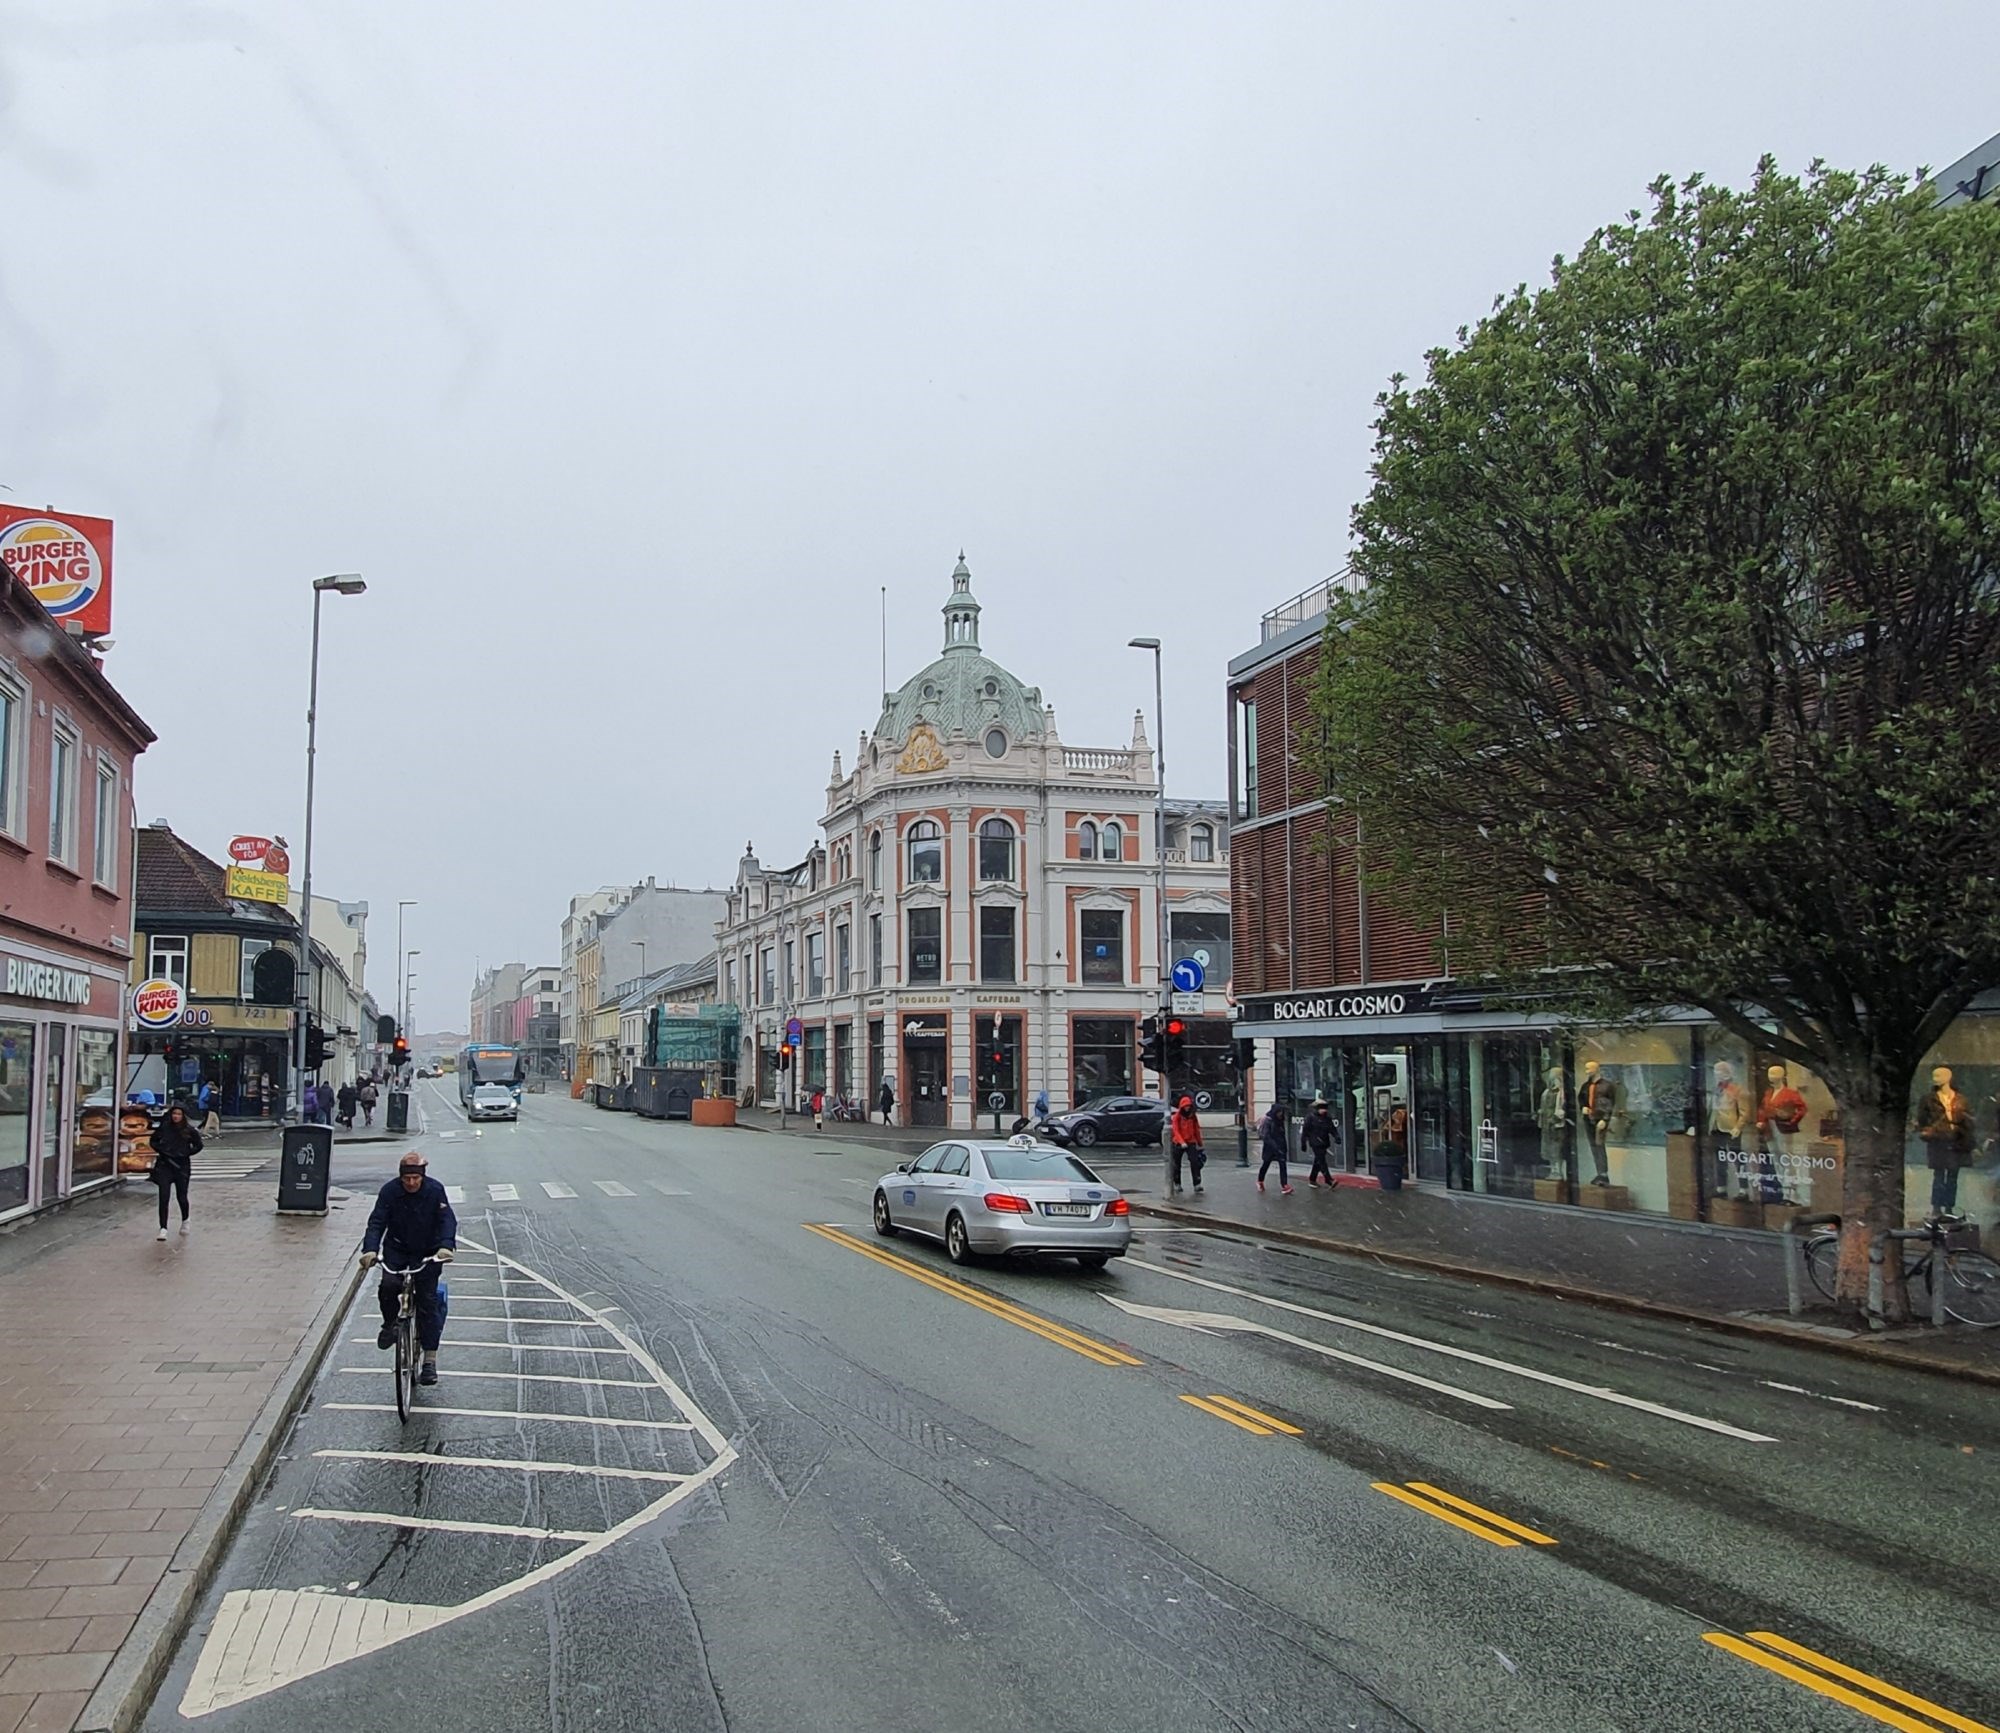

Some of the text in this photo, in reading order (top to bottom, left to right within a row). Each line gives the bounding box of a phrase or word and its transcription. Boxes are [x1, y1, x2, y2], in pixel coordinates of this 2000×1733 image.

[3, 541, 87, 565] BURGER
[231, 883, 285, 902] KAFFE
[8, 957, 91, 1005] BURGER KING
[138, 989, 178, 1003] BURGER
[138, 997, 178, 1014] KING
[898, 995, 1021, 1004] DROMEDAR KAFFEBAR
[1274, 994, 1405, 1020] BOGART.COSMO
